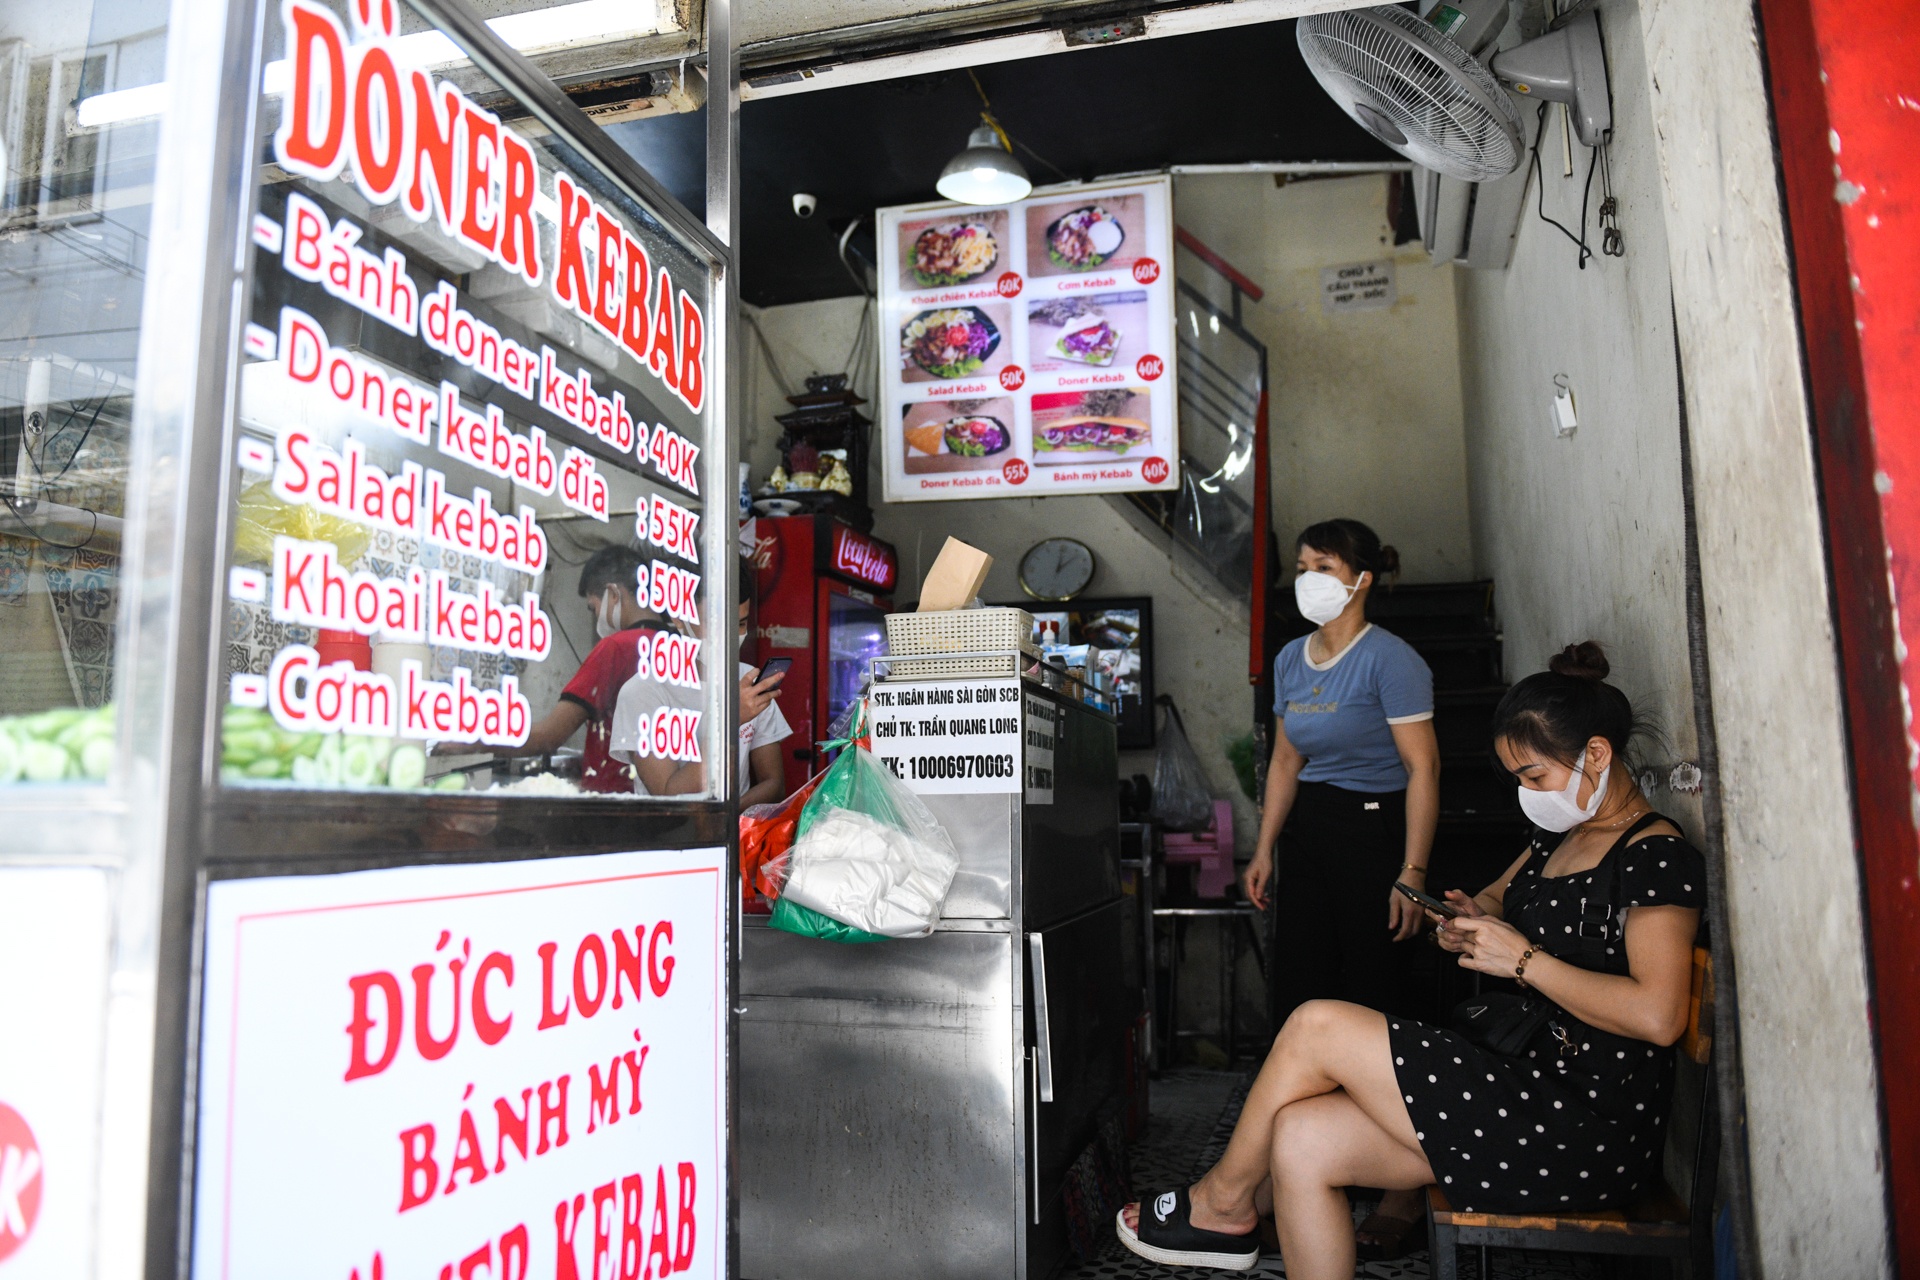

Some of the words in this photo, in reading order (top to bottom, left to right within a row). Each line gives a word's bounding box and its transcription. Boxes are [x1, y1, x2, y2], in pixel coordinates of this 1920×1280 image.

[285, 0, 540, 281] DÖNER
[555, 179, 704, 410] KEBAB
[1135, 263, 1158, 280] 60K
[999, 277, 1021, 294] 60K
[1083, 277, 1116, 288] Kebab
[968, 288, 1000, 299] Kebab
[293, 205, 413, 325] Bánh
[426, 291, 537, 394] doner
[543, 353, 632, 449] kebab
[1001, 369, 1024, 387] 50K
[1137, 359, 1162, 377] 40K
[927, 385, 954, 396] Salad
[956, 383, 987, 394] Kebab
[1057, 377, 1089, 386] Doner
[1091, 373, 1125, 384] Kebab
[286, 318, 434, 436] Doner
[444, 391, 554, 492] kebab
[562, 454, 607, 516] đĩa
[1005, 463, 1027, 481] 55K
[1053, 470, 1079, 481] Bánh
[1099, 468, 1133, 479] Kebab
[1144, 461, 1168, 479] 40K
[920, 479, 950, 489] Doner
[952, 476, 984, 487] Kebab
[283, 431, 417, 530] Salad
[430, 479, 544, 570] kebab
[282, 548, 422, 633] Khoai
[435, 578, 548, 655] kebab
[277, 655, 391, 728] Cơm
[405, 668, 527, 739] kebab
[874, 692, 895, 707] STK:
[897, 688, 925, 706] NGÂN
[927, 687, 954, 705] HÀNG
[956, 686, 973, 704] SÀI
[976, 685, 997, 704] GÒN
[999, 687, 1019, 702] SCB
[876, 715, 897, 738] CHỦ
[899, 721, 916, 737] TK:
[918, 714, 947, 737] TRẦN
[949, 719, 987, 738] QUANG
[989, 718, 1018, 734] LONG
[909, 754, 1014, 780] 10006970003
[344, 930, 515, 1083] ĐỨC
[536, 920, 676, 1032] LONG
[397, 1082, 572, 1215] BÁNH
[586, 1029, 651, 1135] MỲ
[553, 1161, 697, 1280] KEBAB
